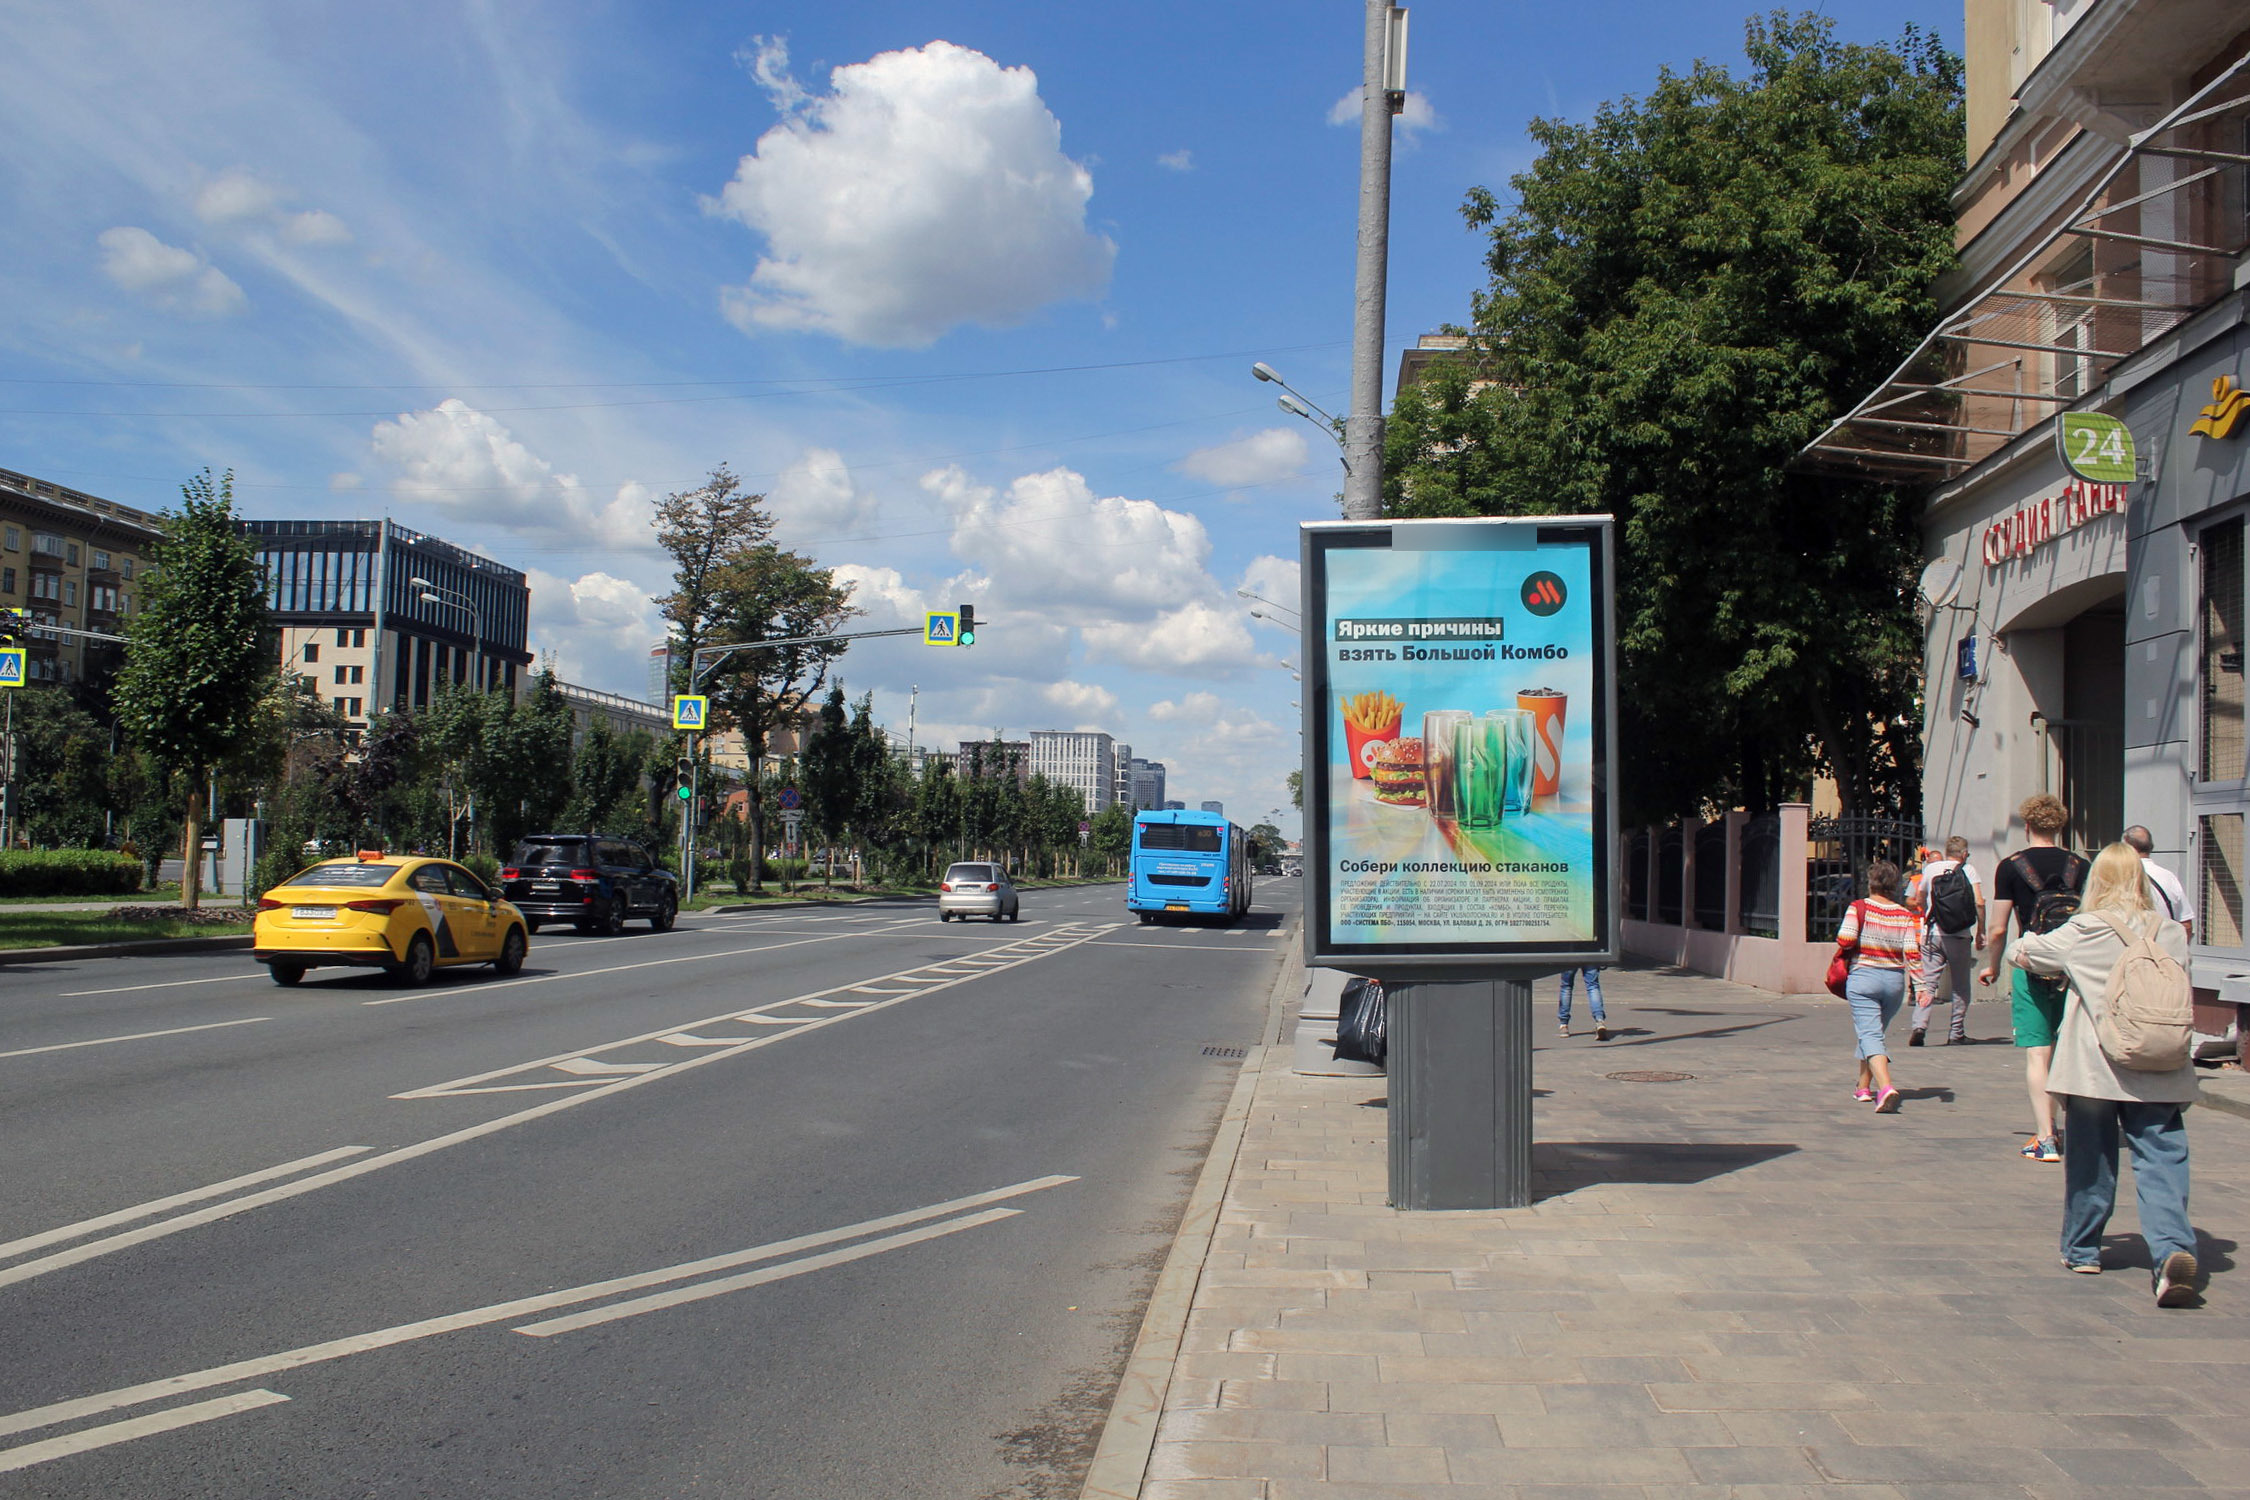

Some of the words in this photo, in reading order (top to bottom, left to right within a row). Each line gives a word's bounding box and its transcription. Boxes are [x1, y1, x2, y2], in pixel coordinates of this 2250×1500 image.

[2072, 428, 2127, 465] 24
[1983, 497, 2053, 567] СТУДИЯ
[2063, 481, 2128, 529] ТАНЦ
[1339, 620, 1403, 639] Яркие
[1408, 621, 1501, 639] причины
[1339, 647, 1396, 661] взять
[1402, 643, 1496, 661] Большой
[1501, 644, 1569, 660] Комбо
[1340, 859, 1398, 876] Собери
[1402, 860, 1492, 874] коллекцию
[1496, 861, 1569, 873] стаканов
